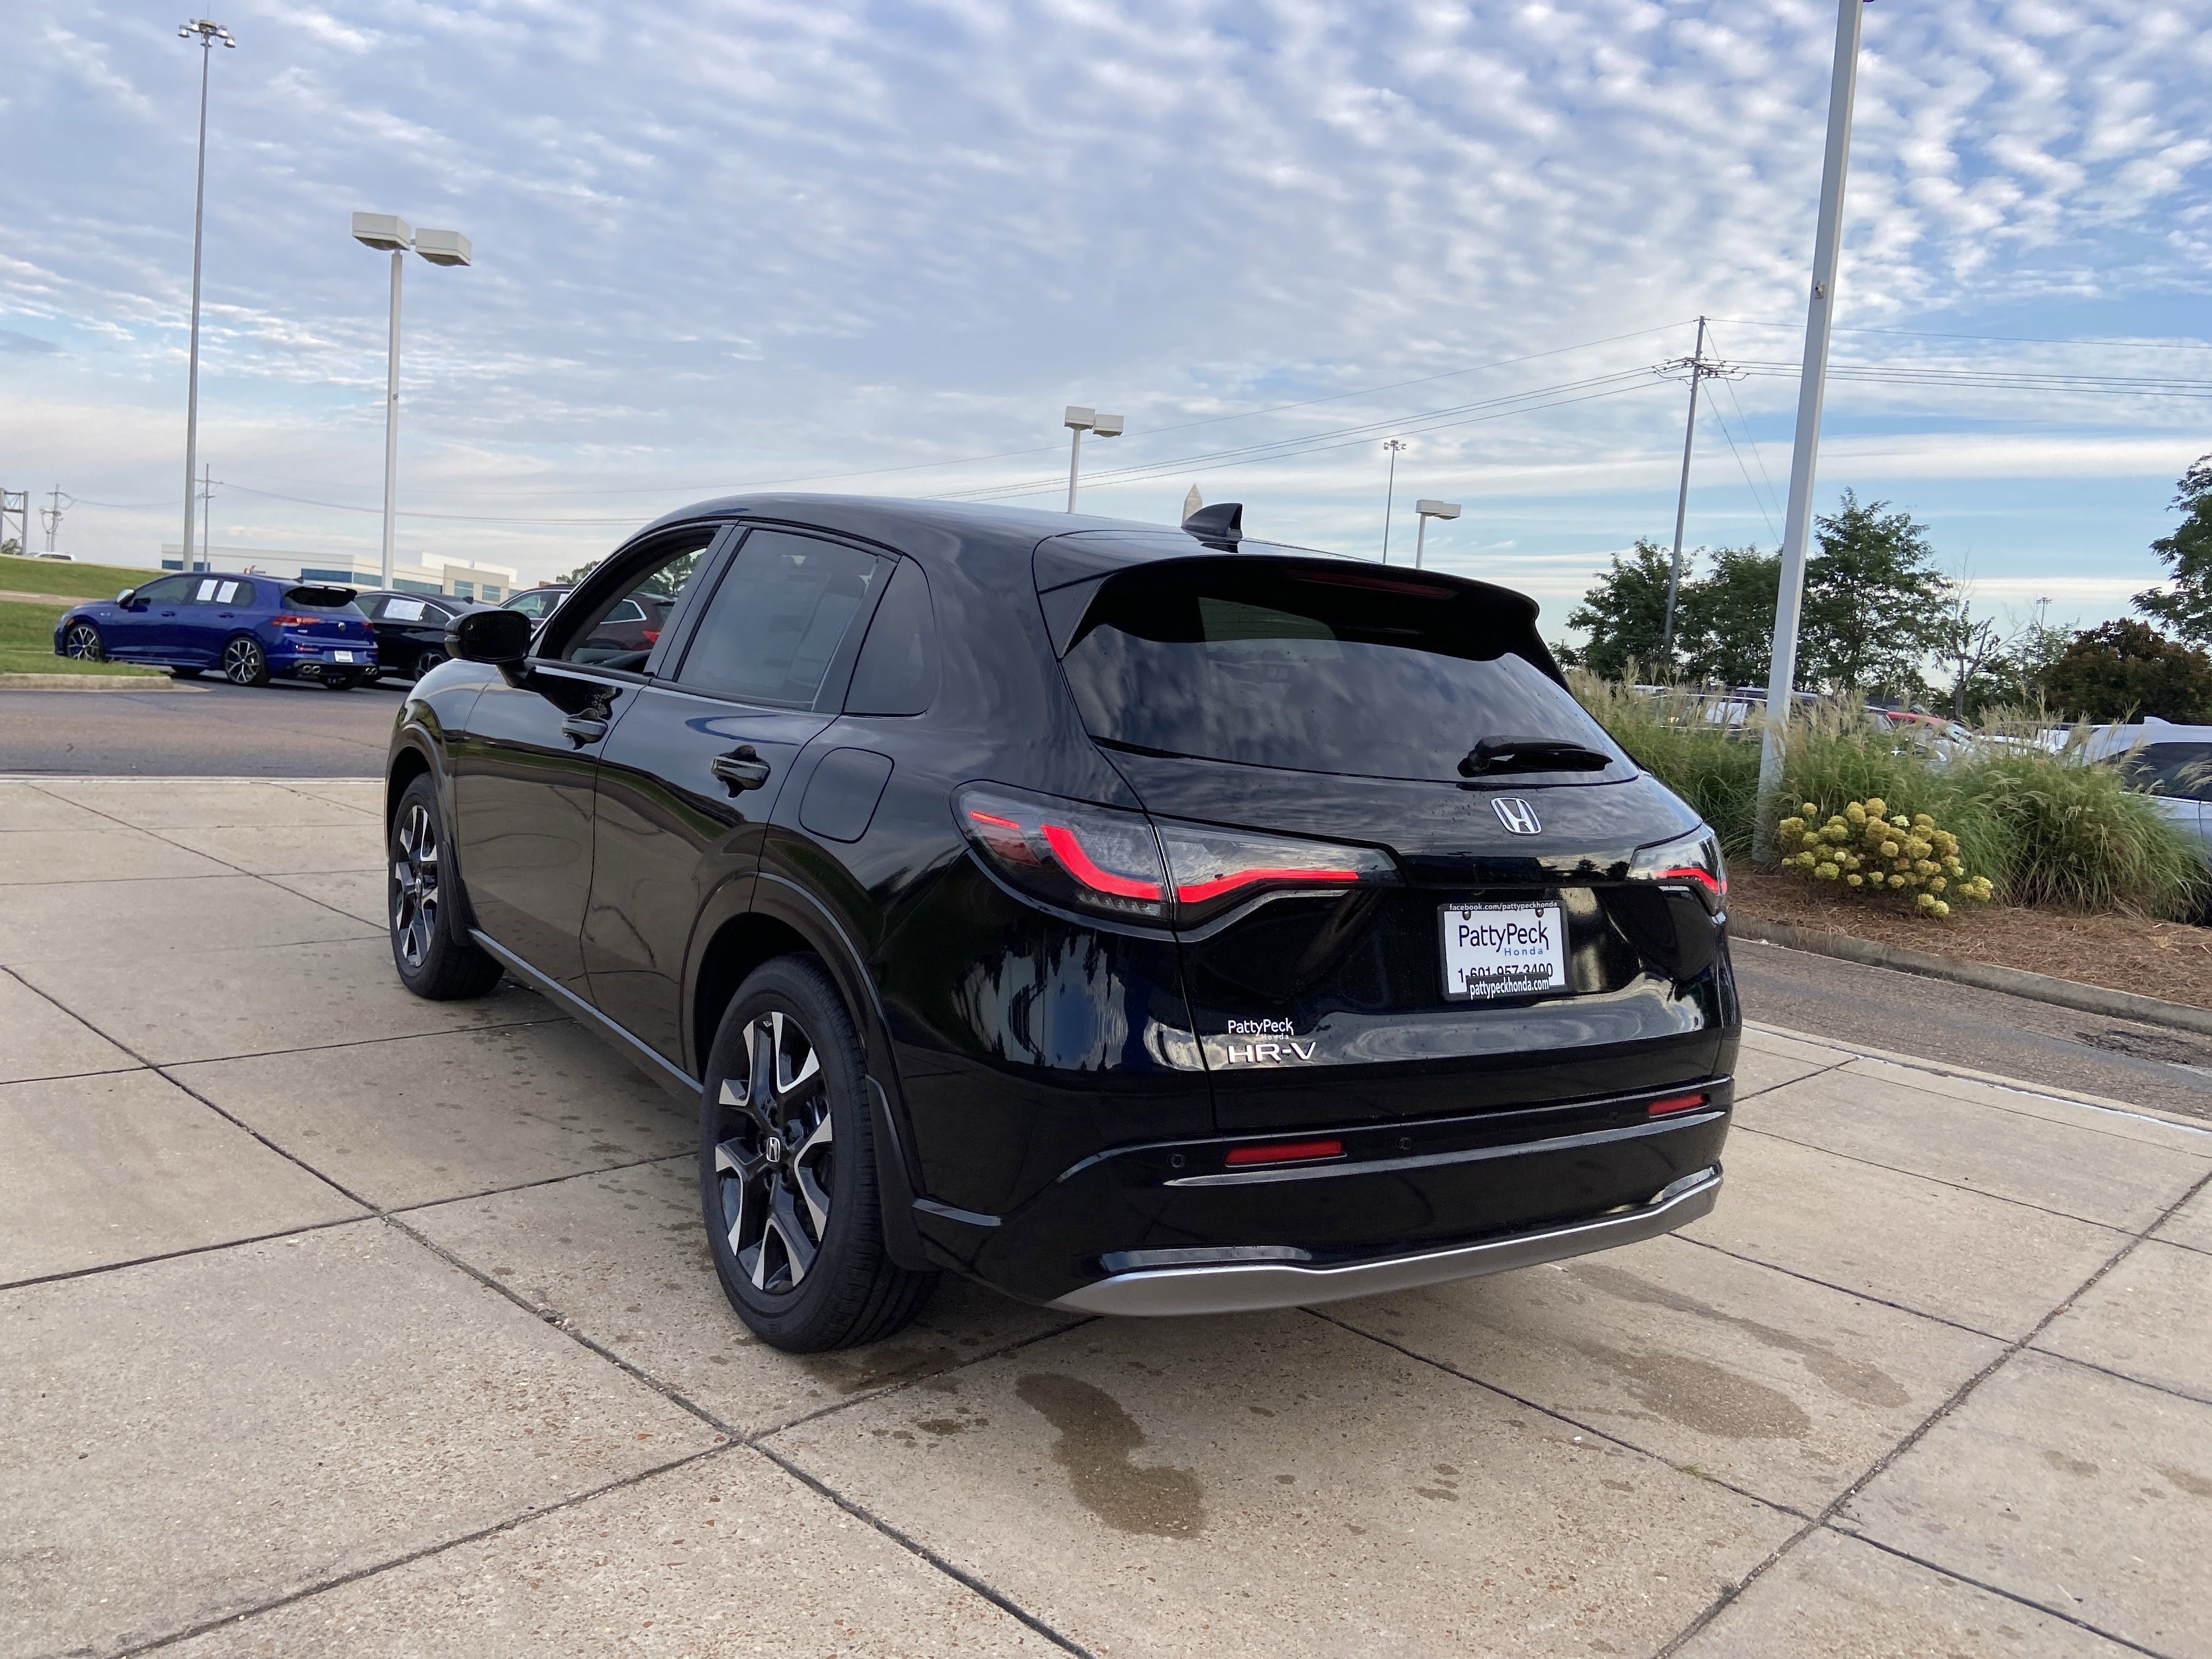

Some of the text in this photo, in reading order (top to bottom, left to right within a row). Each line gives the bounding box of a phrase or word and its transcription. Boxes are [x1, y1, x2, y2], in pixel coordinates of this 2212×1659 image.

[1449, 901, 1557, 911] facebook.com/pattypeckhonda
[1459, 921, 1549, 952] PattyPeck
[1504, 946, 1543, 956] Honda
[1469, 975, 1549, 1000] pattypeckhonda.com
[1228, 1018, 1294, 1036] PattyPeck
[1227, 1041, 1316, 1064] HR-V
